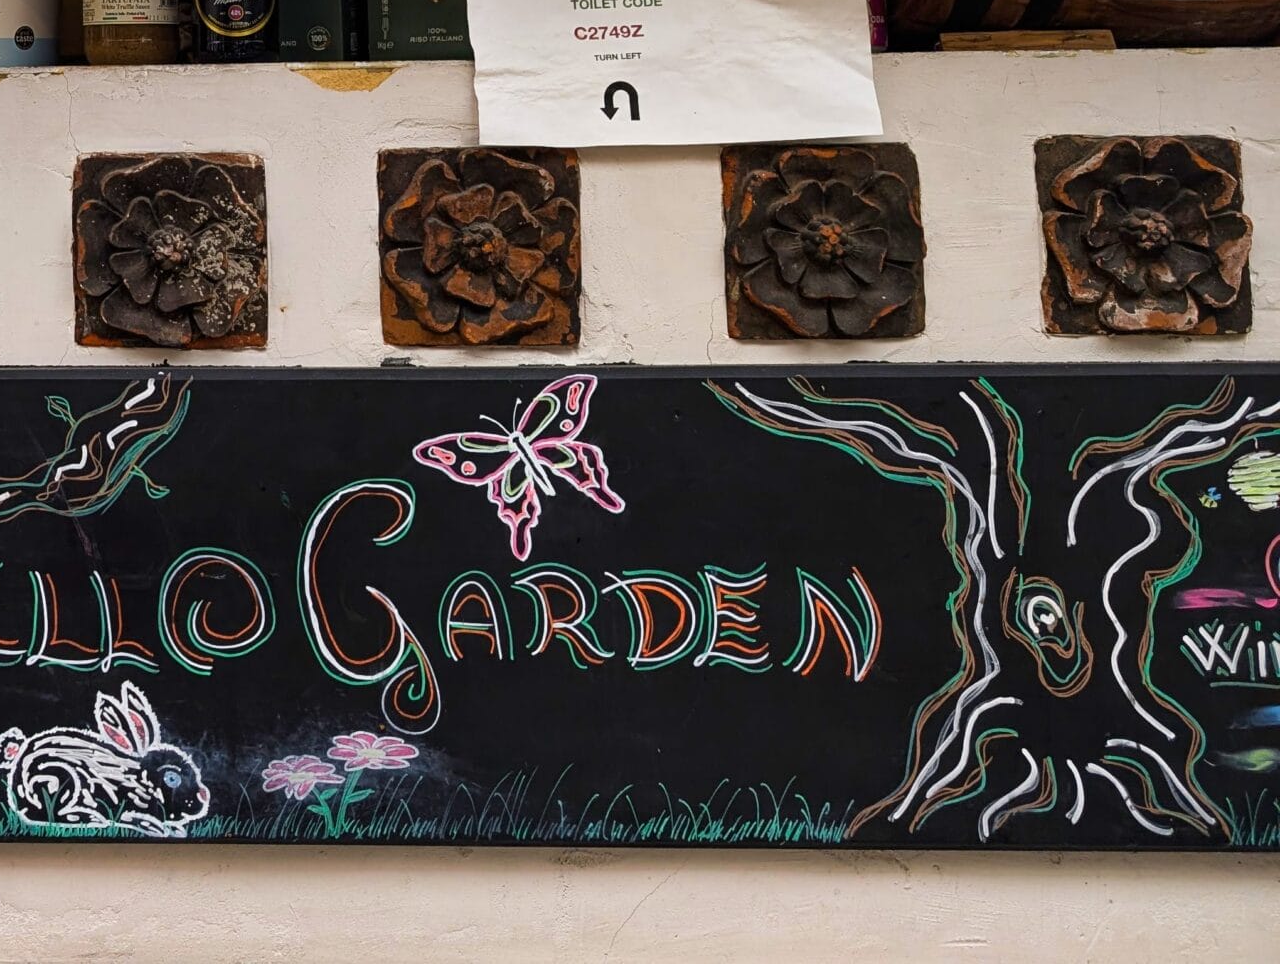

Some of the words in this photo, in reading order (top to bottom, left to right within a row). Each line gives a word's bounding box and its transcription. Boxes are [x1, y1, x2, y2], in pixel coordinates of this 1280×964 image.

[574, 24, 645, 42] C2749Z
[593, 54, 618, 63] TURN
[620, 52, 642, 61] LEFT
[297, 478, 883, 735] GARDEN
